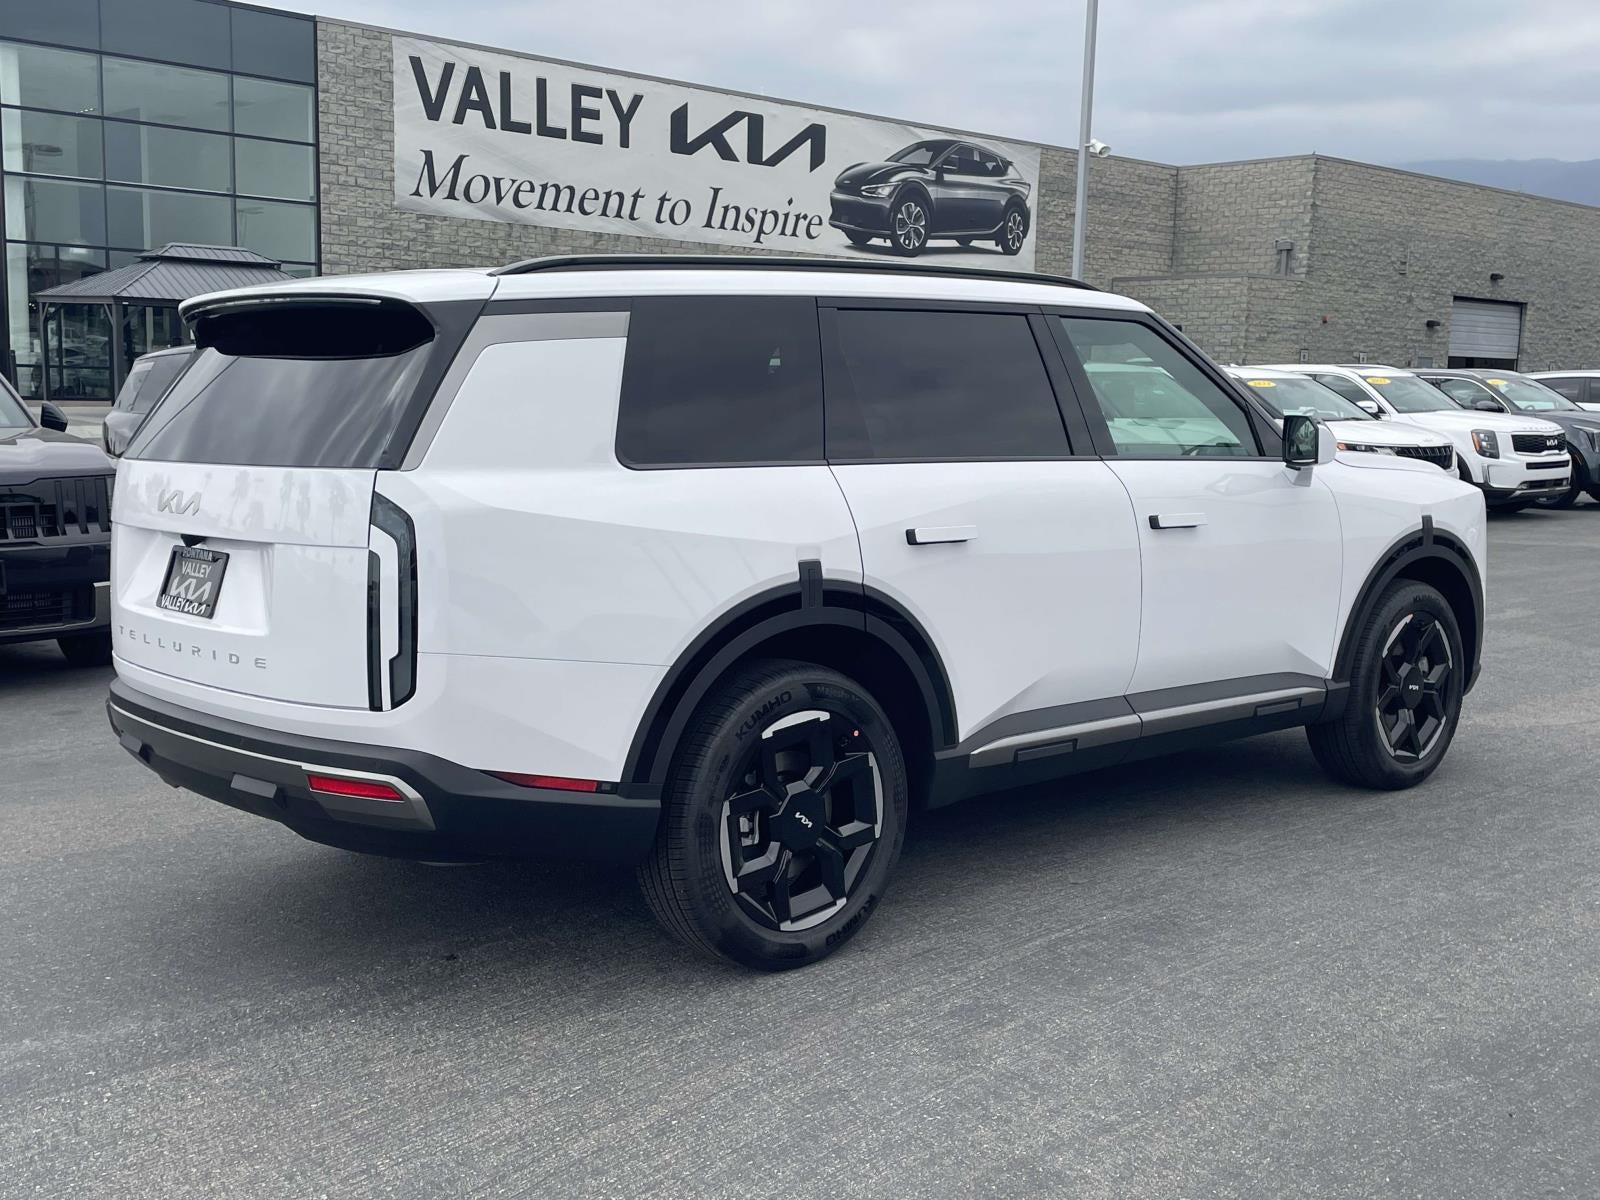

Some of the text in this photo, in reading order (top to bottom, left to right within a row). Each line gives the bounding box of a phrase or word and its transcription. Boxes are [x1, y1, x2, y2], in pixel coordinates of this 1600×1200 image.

[408, 55, 826, 173] VALLEY KIA
[409, 149, 823, 244] Movement to Inspire
[157, 488, 202, 517] KIA
[182, 547, 213, 561] FONTANA
[182, 561, 212, 578] VALLEY
[170, 575, 212, 602] KIA
[161, 594, 206, 614] VALLEY KIA
[118, 625, 267, 669] TELLURIDE
[735, 690, 792, 741] KUMHO
